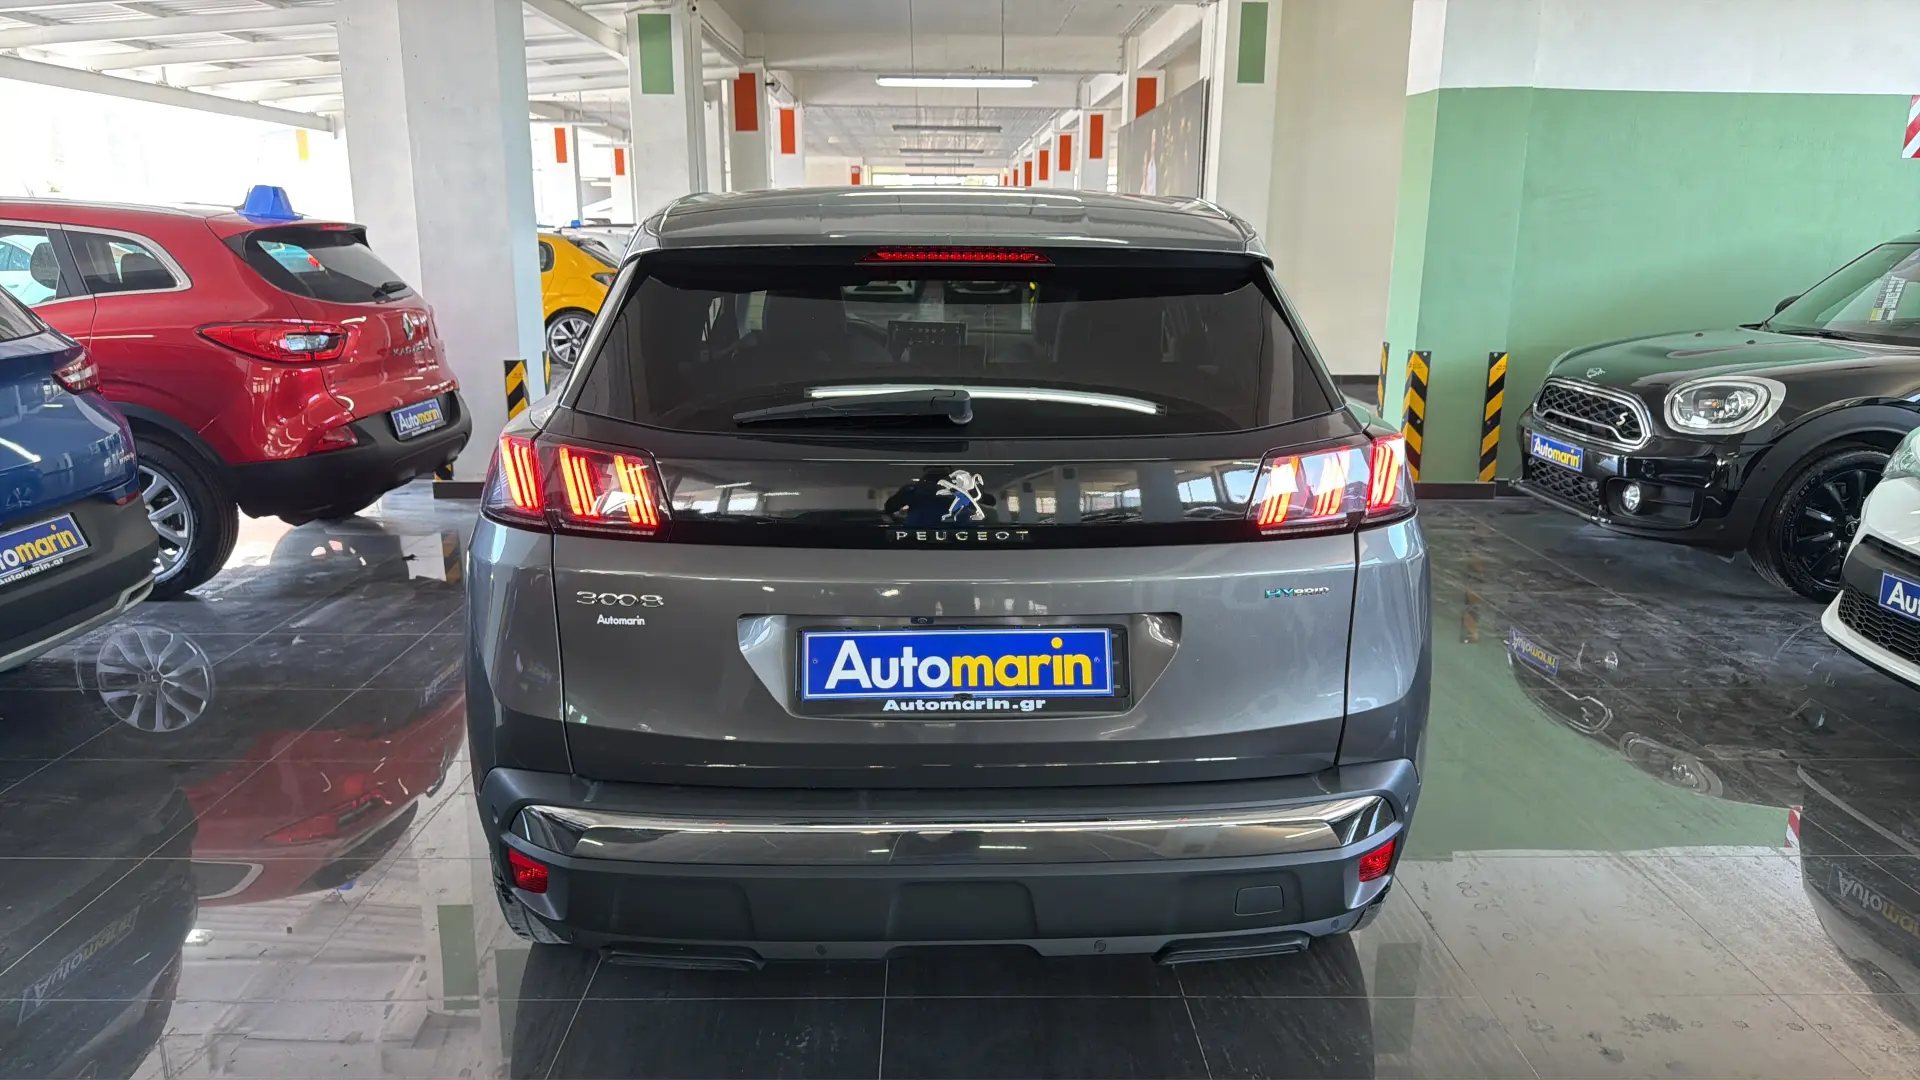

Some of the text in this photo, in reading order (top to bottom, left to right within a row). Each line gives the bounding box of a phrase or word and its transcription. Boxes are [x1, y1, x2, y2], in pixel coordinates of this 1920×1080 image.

[399, 403, 439, 432] Automarin
[1533, 437, 1580, 468] Automarin
[895, 530, 1029, 541] PEUGEOT
[576, 590, 664, 608] 3008
[596, 613, 646, 626] Automarin
[824, 636, 1094, 690] Automarin
[882, 697, 1047, 712] Automarin.gr
